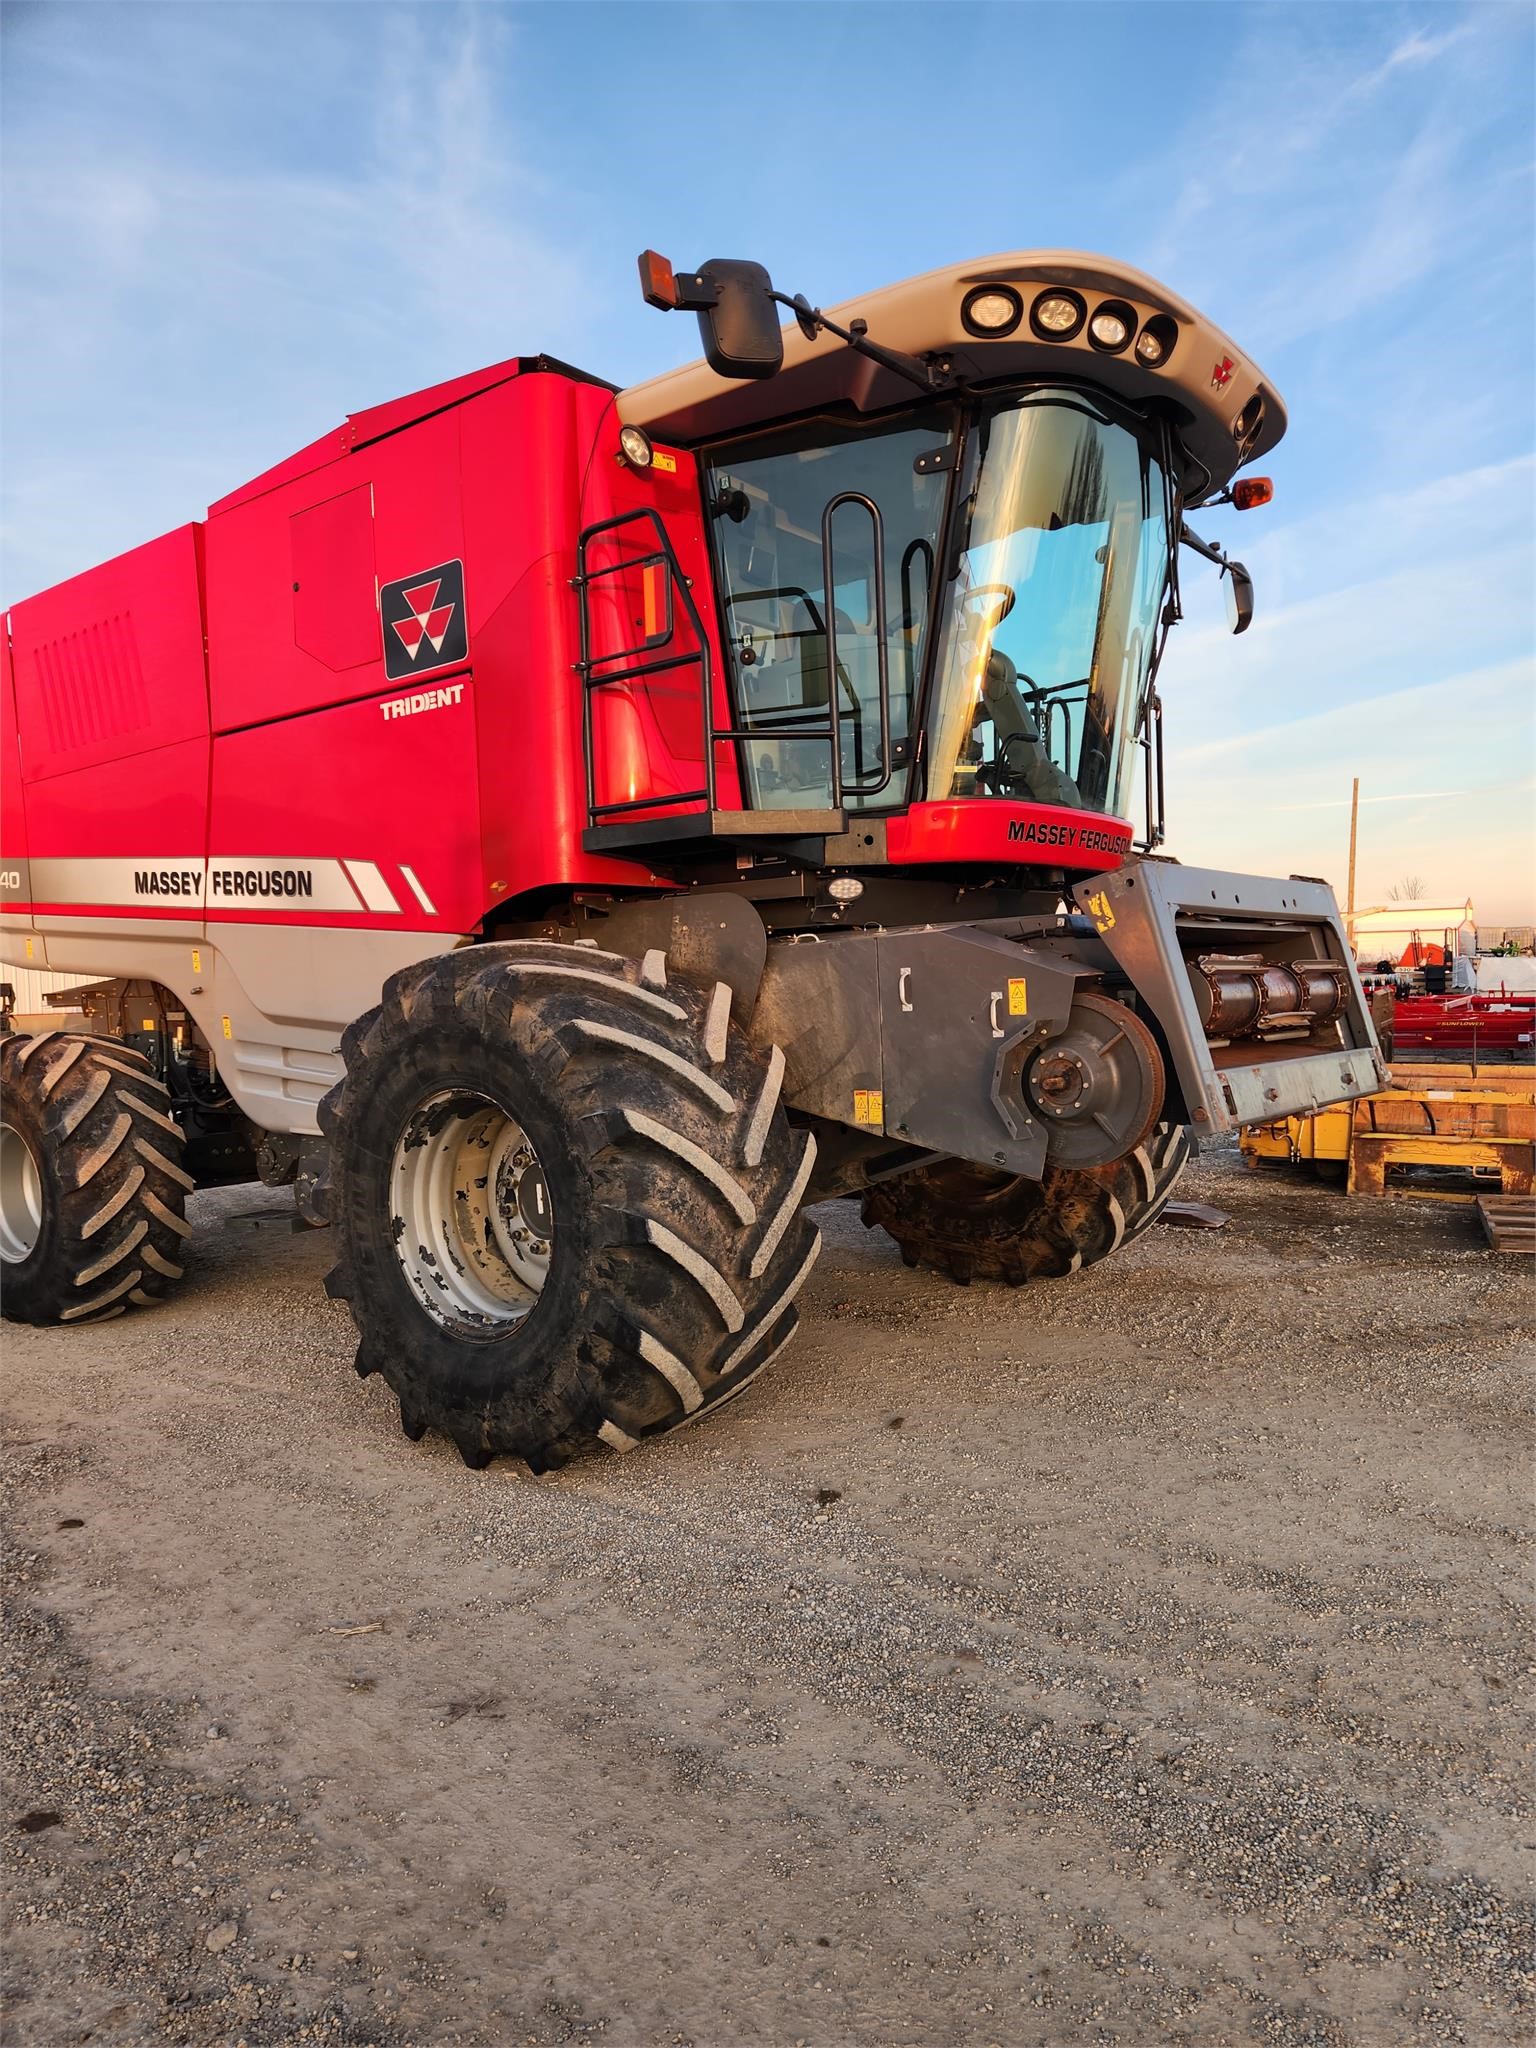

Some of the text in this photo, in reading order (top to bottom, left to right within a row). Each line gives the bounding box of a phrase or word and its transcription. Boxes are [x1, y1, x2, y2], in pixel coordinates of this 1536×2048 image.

[380, 683, 464, 721] TRIDENT
[1008, 820, 1076, 847] MASSEY
[134, 870, 313, 897] MASSEY FERGUSON
